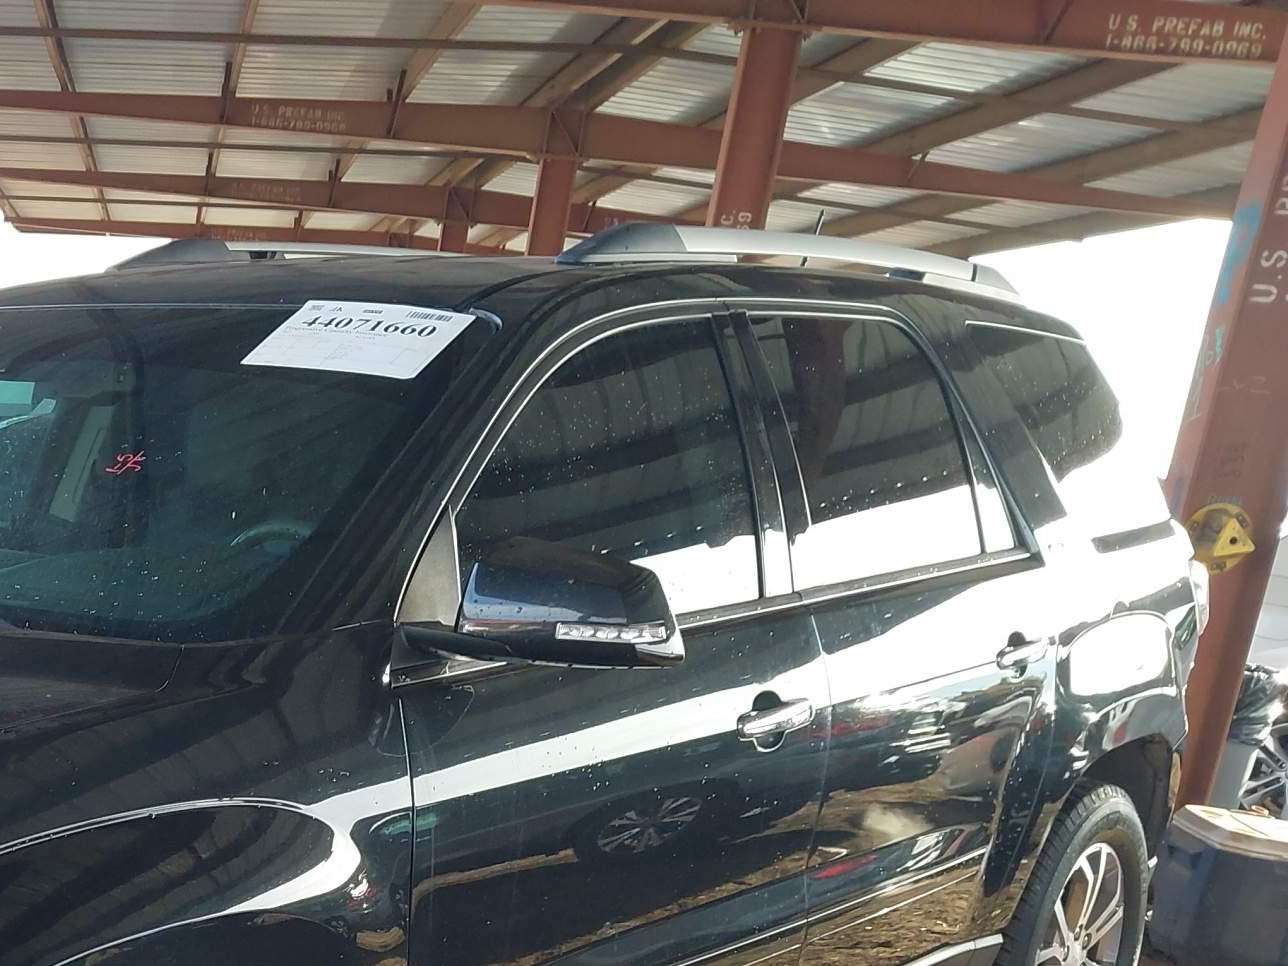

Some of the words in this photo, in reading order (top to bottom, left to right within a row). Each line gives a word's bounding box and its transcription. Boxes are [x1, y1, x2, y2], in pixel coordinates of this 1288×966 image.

[1152, 16, 1225, 38] PREFAB
[1233, 20, 1267, 40] INC.
[302, 315, 437, 338] 44071660
